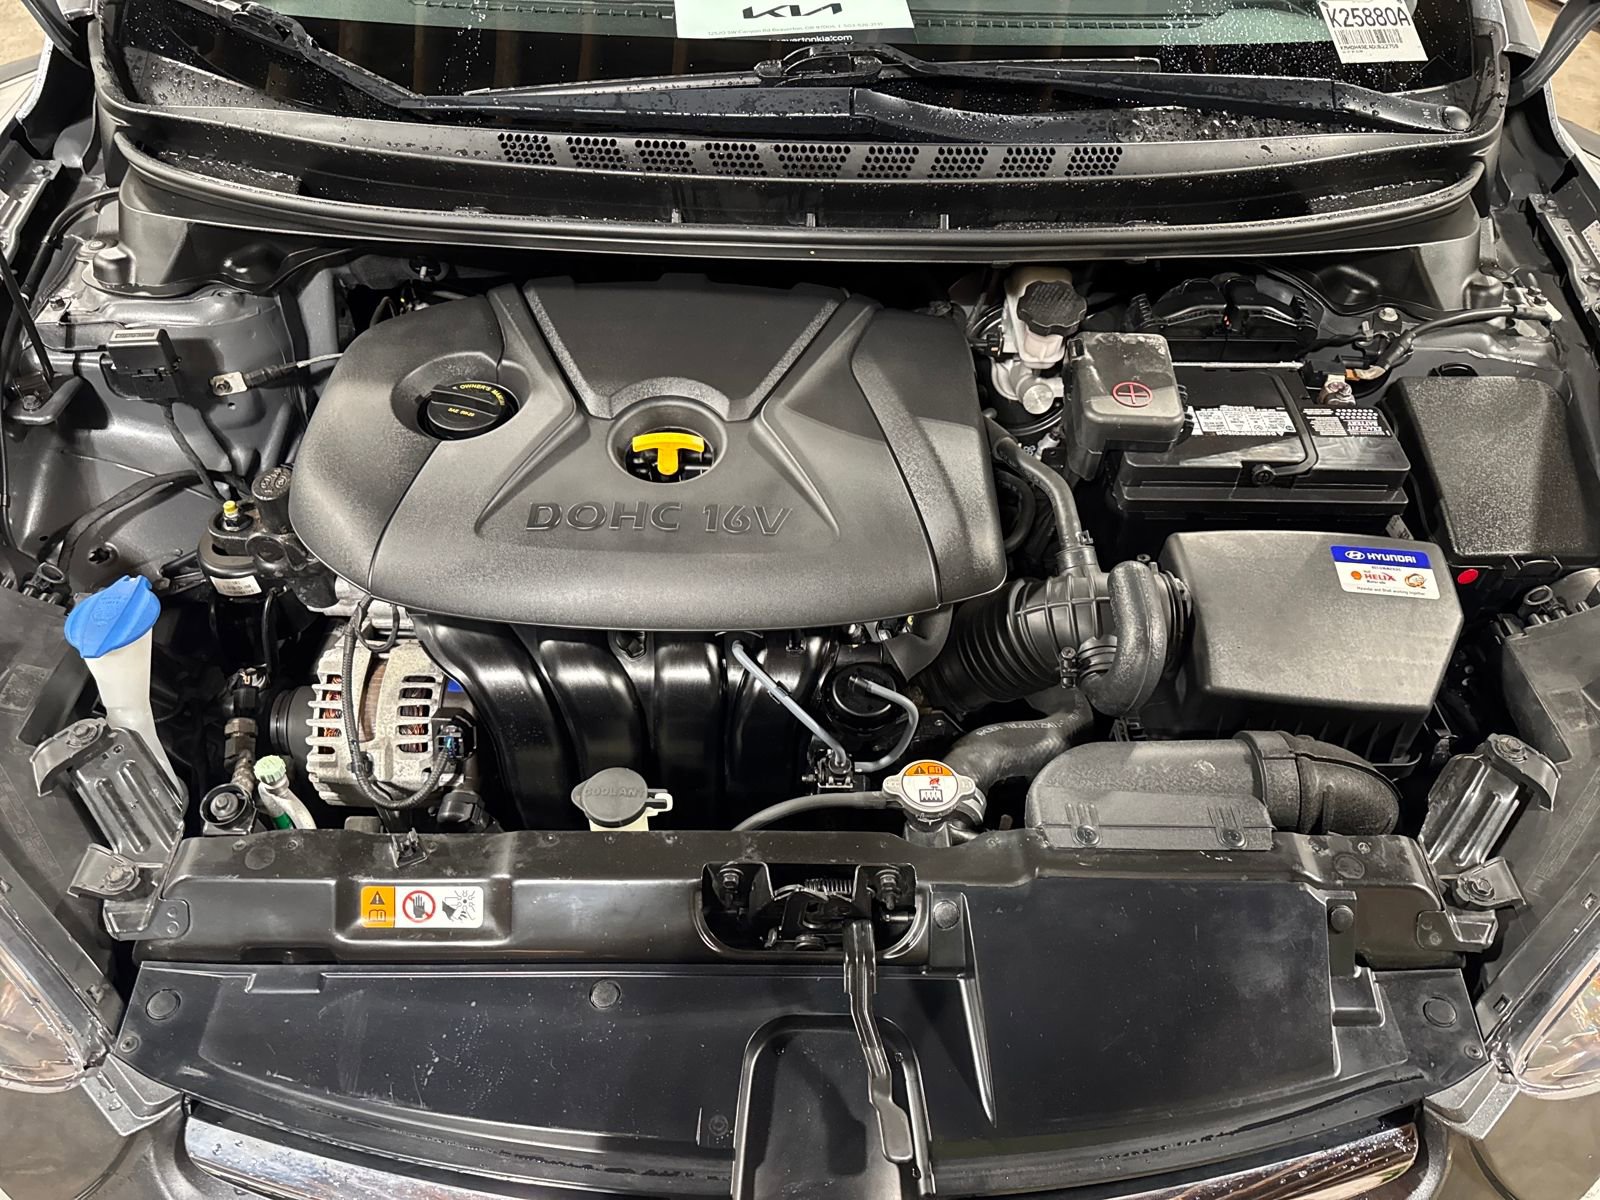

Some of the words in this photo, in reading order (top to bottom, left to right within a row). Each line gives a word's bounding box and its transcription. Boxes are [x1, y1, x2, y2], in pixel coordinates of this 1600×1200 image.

[742, 3, 843, 19] KIA
[1326, 7, 1411, 28] K25880A
[526, 501, 683, 531] DOHC
[702, 503, 793, 536] 16V
[1367, 553, 1417, 563] HYUNDAI
[1364, 572, 1397, 581] HELIX
[584, 786, 646, 799] COOLANT
